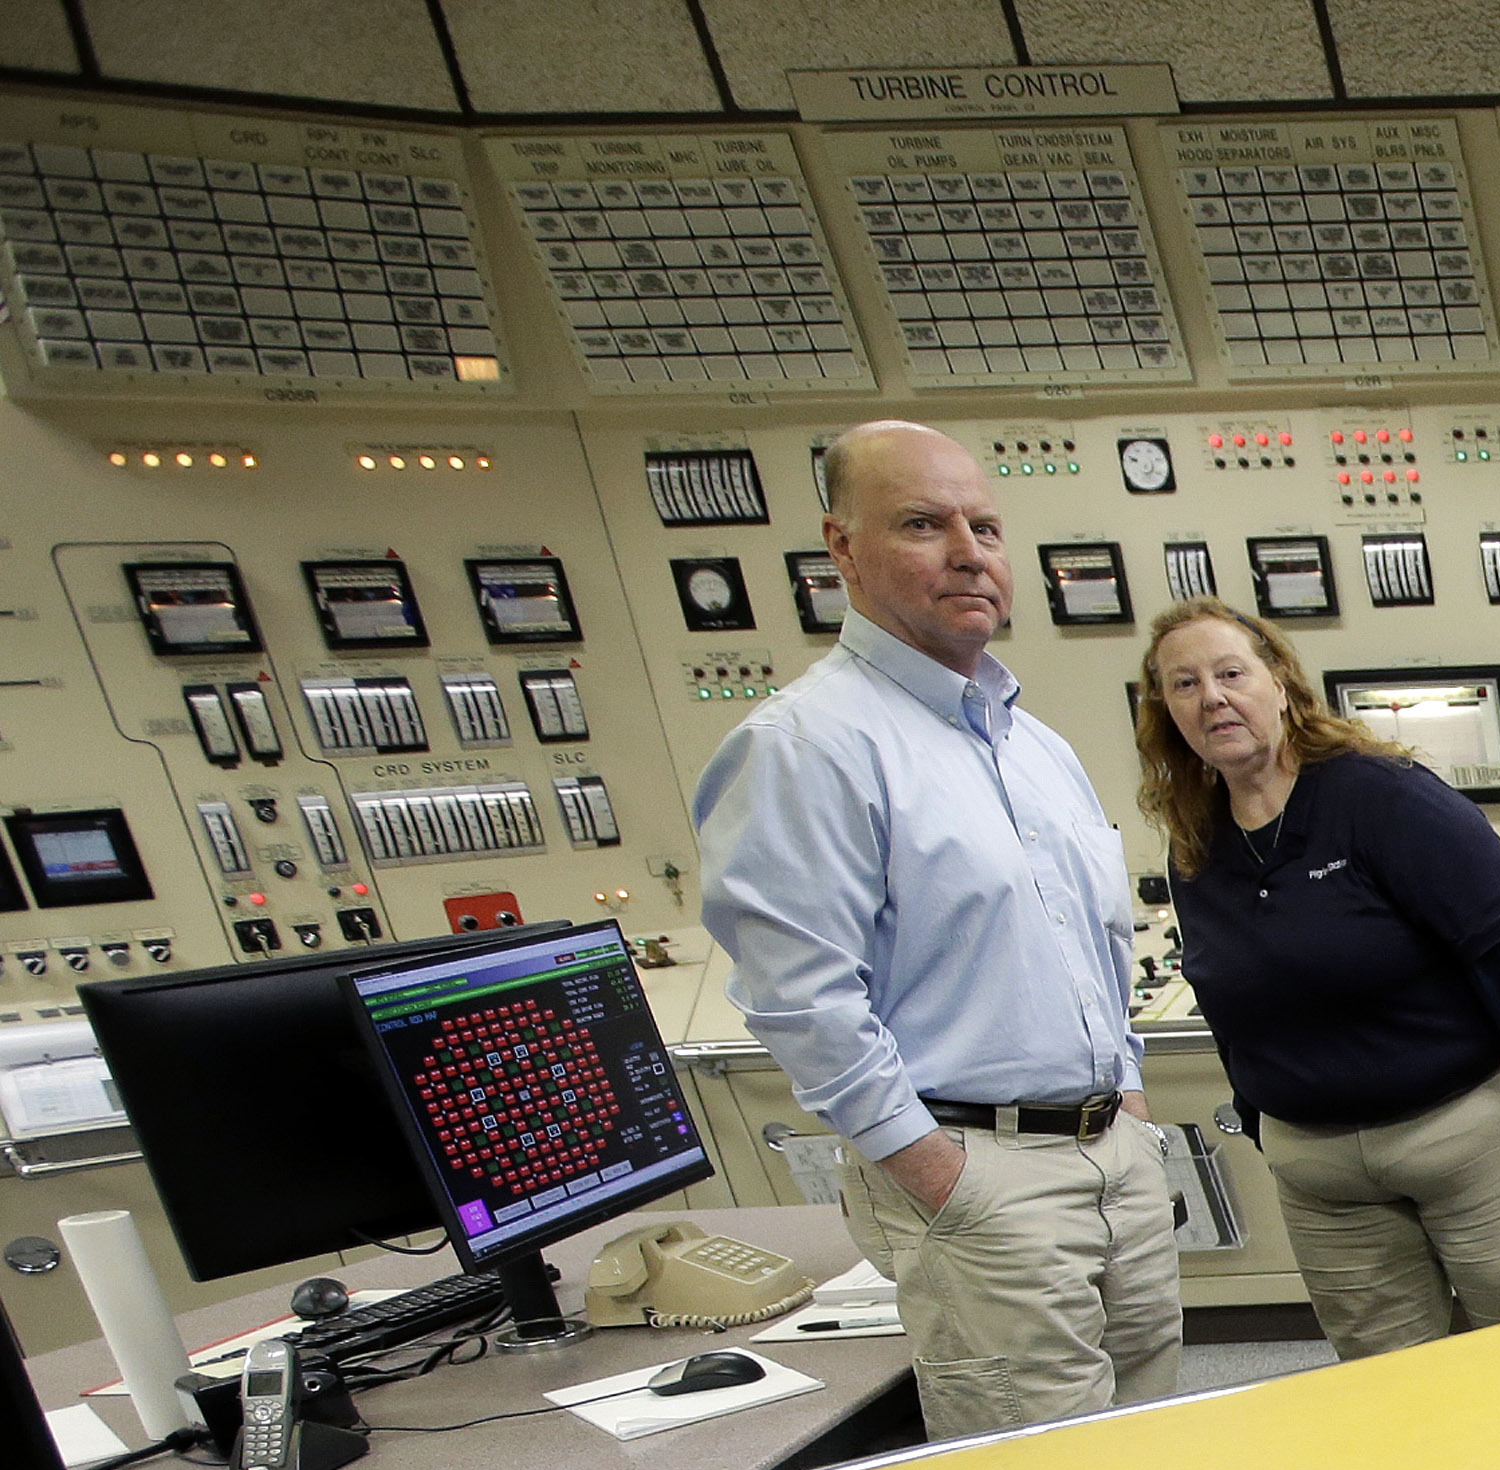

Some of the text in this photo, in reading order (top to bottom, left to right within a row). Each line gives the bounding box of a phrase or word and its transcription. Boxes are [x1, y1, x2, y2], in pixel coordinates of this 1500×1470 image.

[848, 71, 1118, 101] TURBINE CONTROL
[1177, 128, 1204, 144] EXH
[1219, 127, 1280, 143] MOISTURE
[1374, 124, 1400, 139] AUX
[1409, 123, 1442, 139] MISC
[712, 138, 767, 155] TURBINE
[888, 136, 943, 151] TURBINE
[998, 133, 1033, 149] TURN
[1074, 132, 1114, 147] STEAM
[1304, 135, 1358, 151] AIR SYS
[304, 145, 349, 164] CONT
[408, 143, 442, 162] SLC
[512, 141, 567, 157] TURBINE
[592, 141, 646, 157] TURBINE
[1176, 146, 1213, 162] HOOD
[1216, 145, 1292, 162] SEPARATORS
[1374, 143, 1407, 158] BLRS
[1413, 144, 1446, 159] PNLS
[356, 148, 402, 167] CONT
[887, 154, 958, 170] OIL PUMPS
[1003, 151, 1039, 167] GEAR
[1045, 152, 1075, 167] VAC
[1083, 151, 1115, 166] SEAL
[585, 160, 667, 176] MONITORING
[715, 158, 780, 174] LUBE OIL
[1043, 384, 1074, 398] C2C
[553, 751, 586, 765] SLC
[372, 759, 491, 778] CRD SYSTEM
